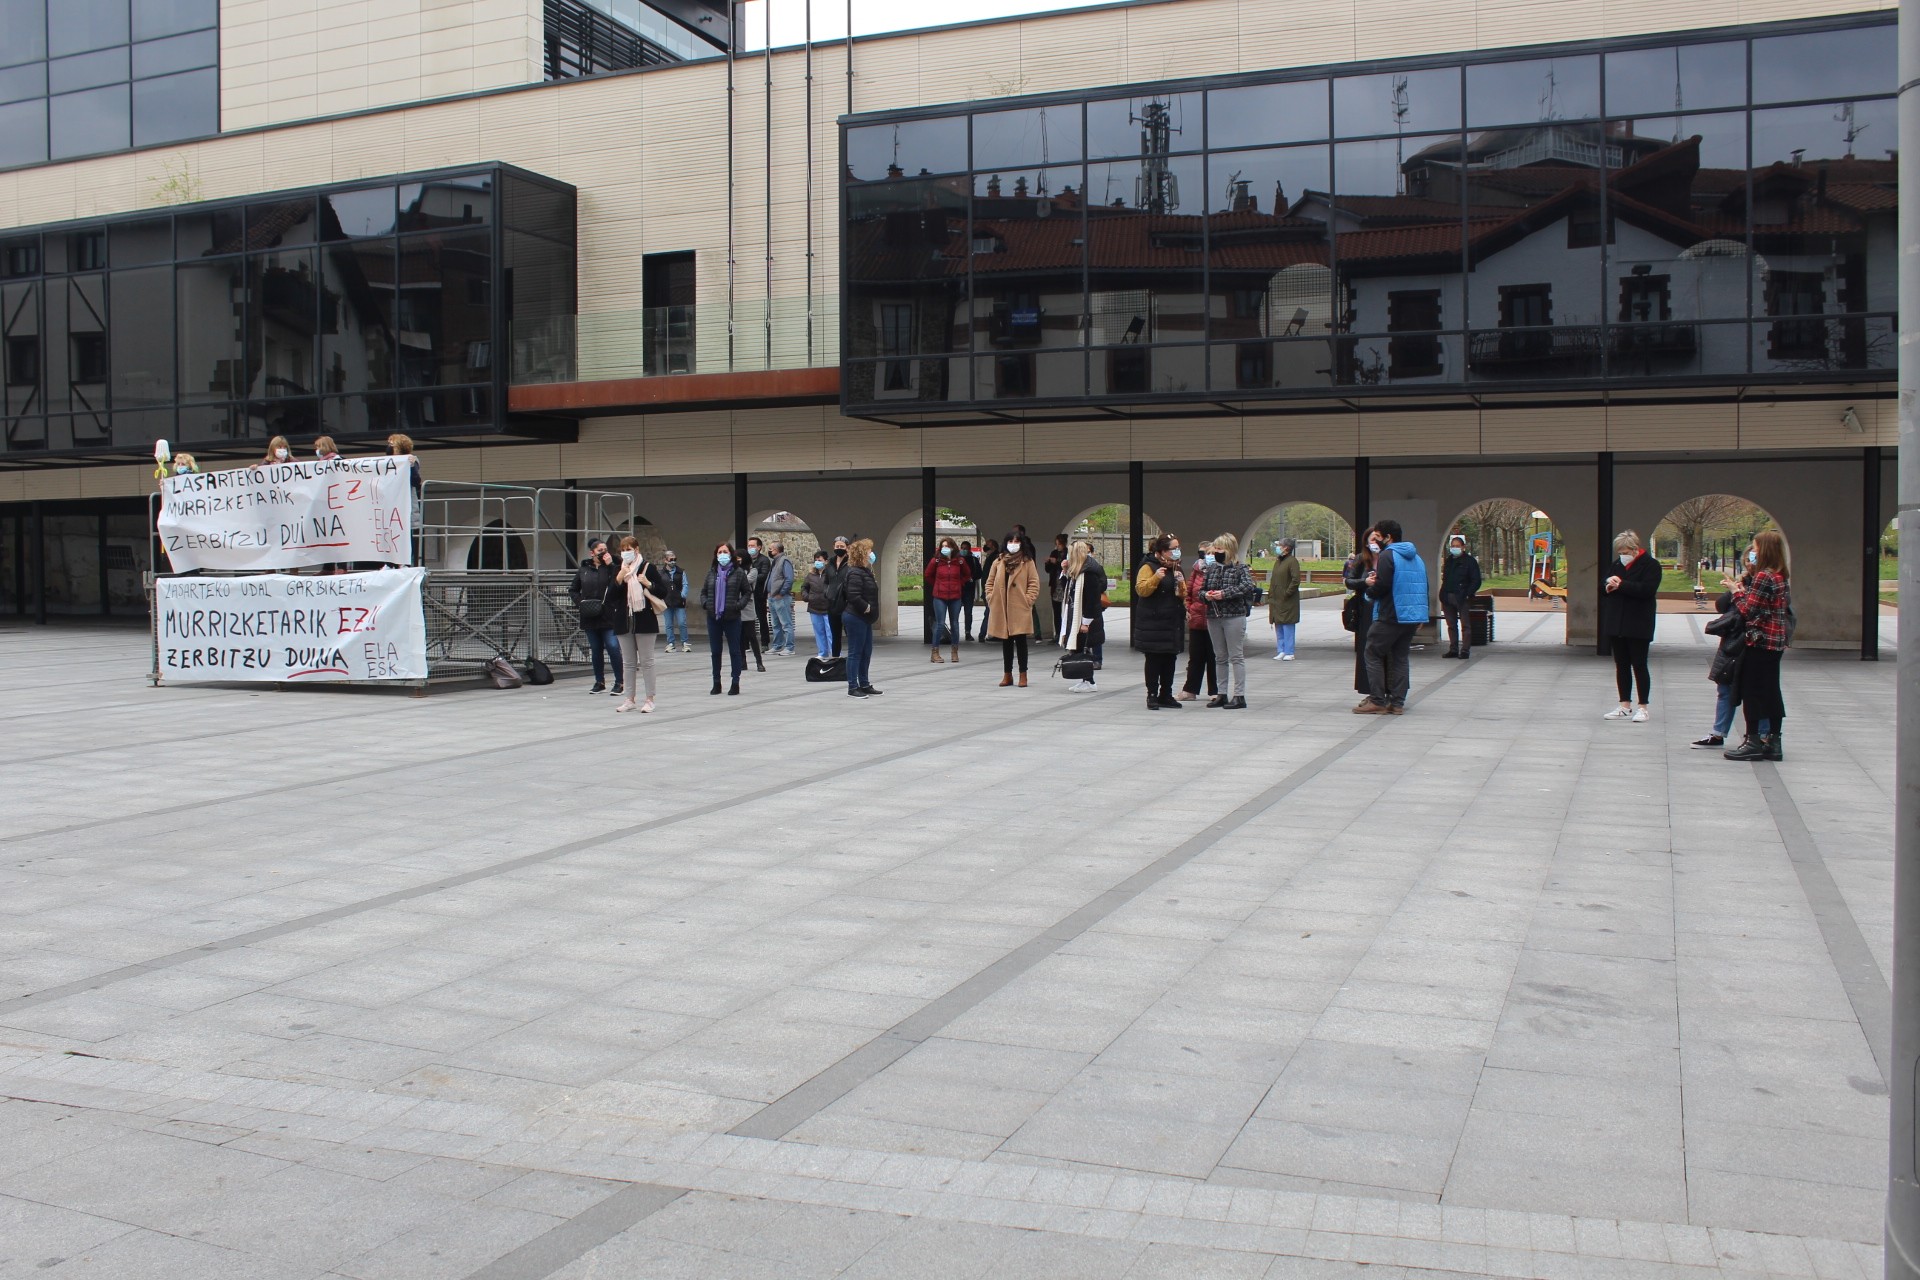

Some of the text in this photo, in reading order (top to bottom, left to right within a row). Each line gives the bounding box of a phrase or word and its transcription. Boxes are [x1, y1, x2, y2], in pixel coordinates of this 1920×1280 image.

[172, 470, 265, 495] LASARTEKO
[270, 463, 313, 484] UDAL
[241, 582, 273, 598] UDAL
[165, 608, 328, 639] MURRIZKETARIK
[166, 646, 349, 670] ZERBITZU DUINA
[364, 641, 399, 661] ELA
[367, 661, 399, 679] ESK
